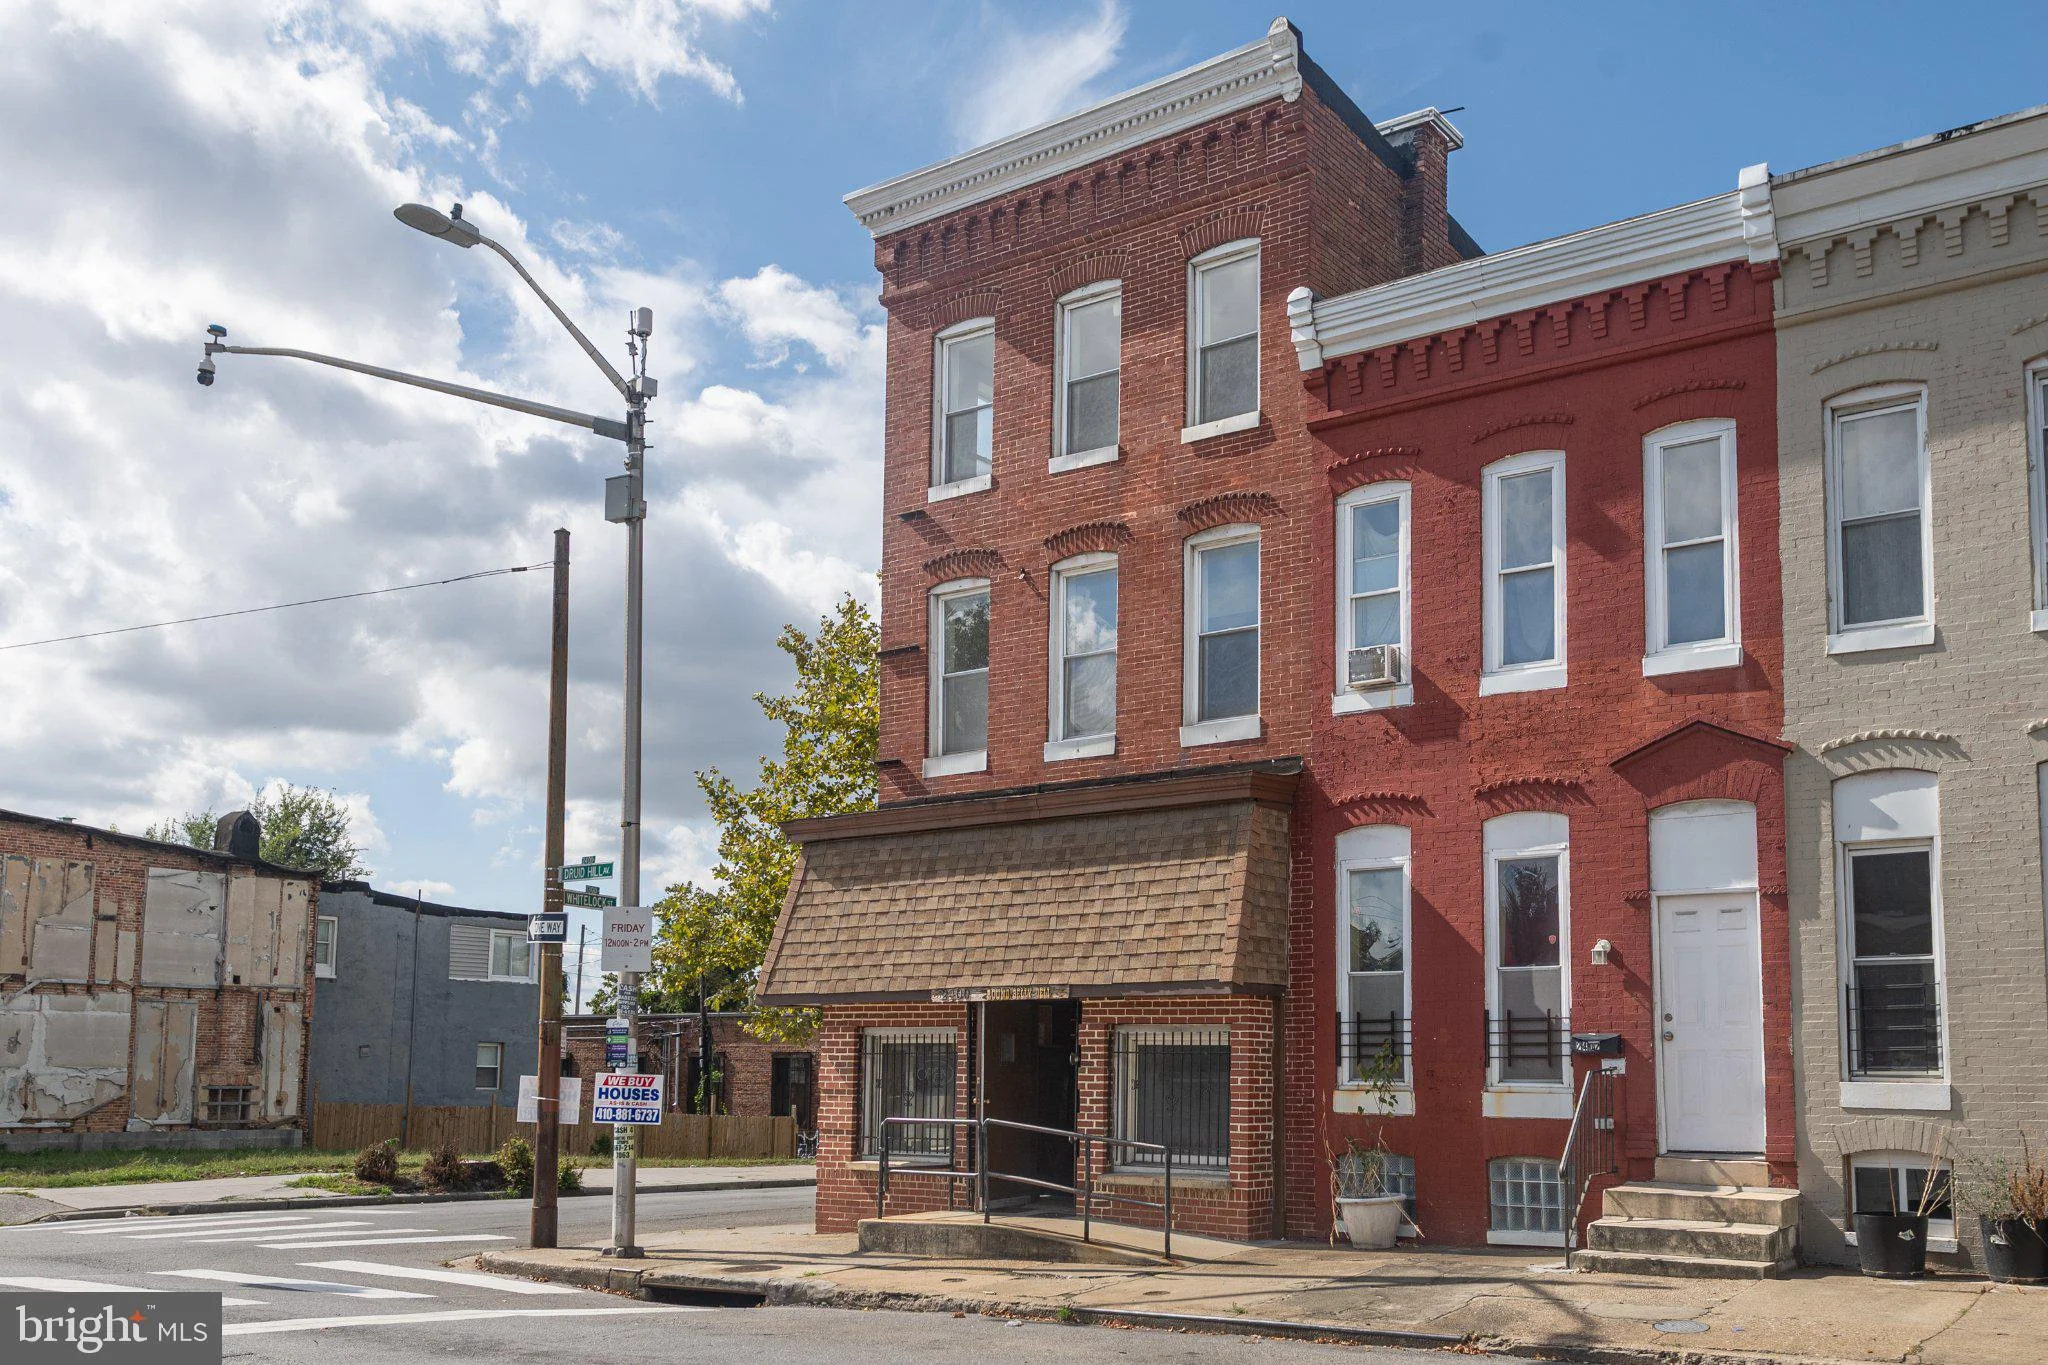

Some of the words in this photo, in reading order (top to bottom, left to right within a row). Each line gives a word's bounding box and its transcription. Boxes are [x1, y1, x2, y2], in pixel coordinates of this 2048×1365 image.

[564, 866, 585, 880] DRUID
[587, 865, 602, 878] HILL
[566, 893, 607, 908] WHITELOCK
[546, 922, 562, 933] WAY
[611, 923, 646, 933] FRIDAY
[607, 1076, 626, 1086] WE
[627, 1077, 652, 1087] BUY
[598, 1087, 660, 1101] HOUSES
[596, 1107, 658, 1122] 410-881-6737
